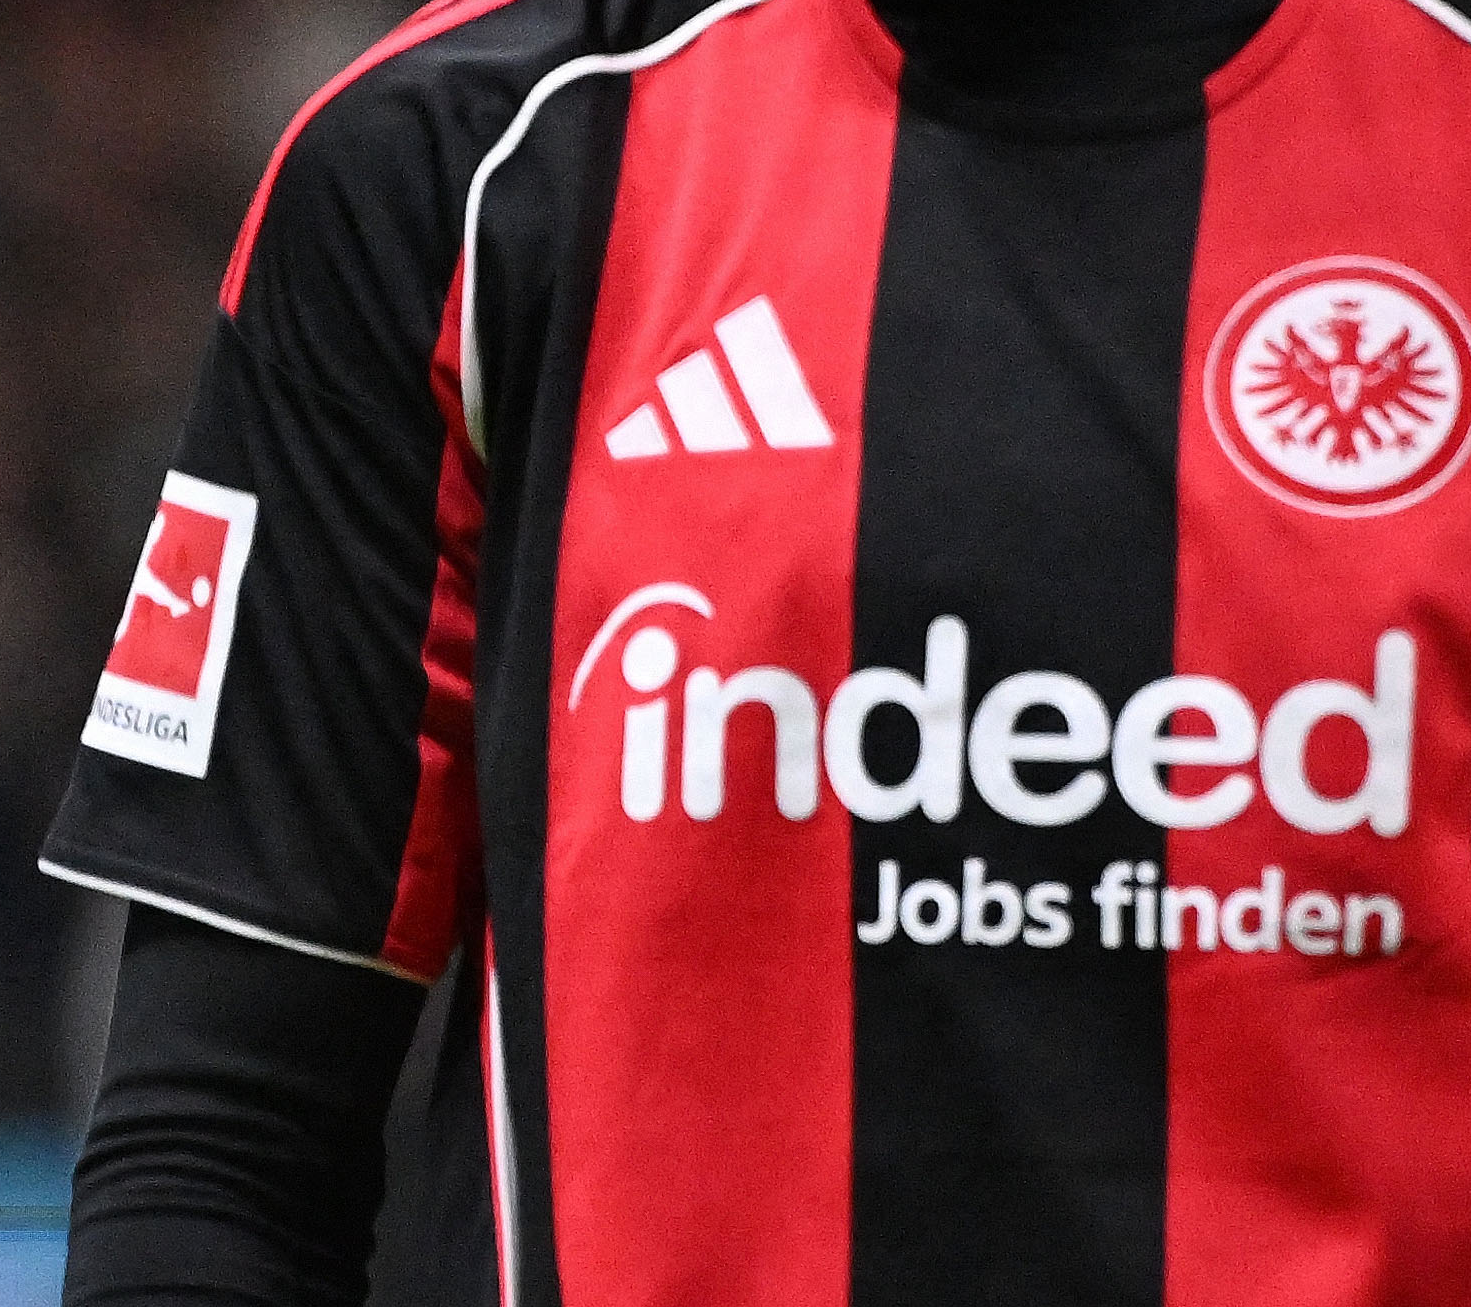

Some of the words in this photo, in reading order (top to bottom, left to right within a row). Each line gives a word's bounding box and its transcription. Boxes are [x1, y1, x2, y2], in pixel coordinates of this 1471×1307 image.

[92, 695, 189, 748] NDESLIGA
[620, 613, 1419, 838] indeed
[857, 857, 1073, 952] Jobs
[1092, 859, 1403, 957] finden
